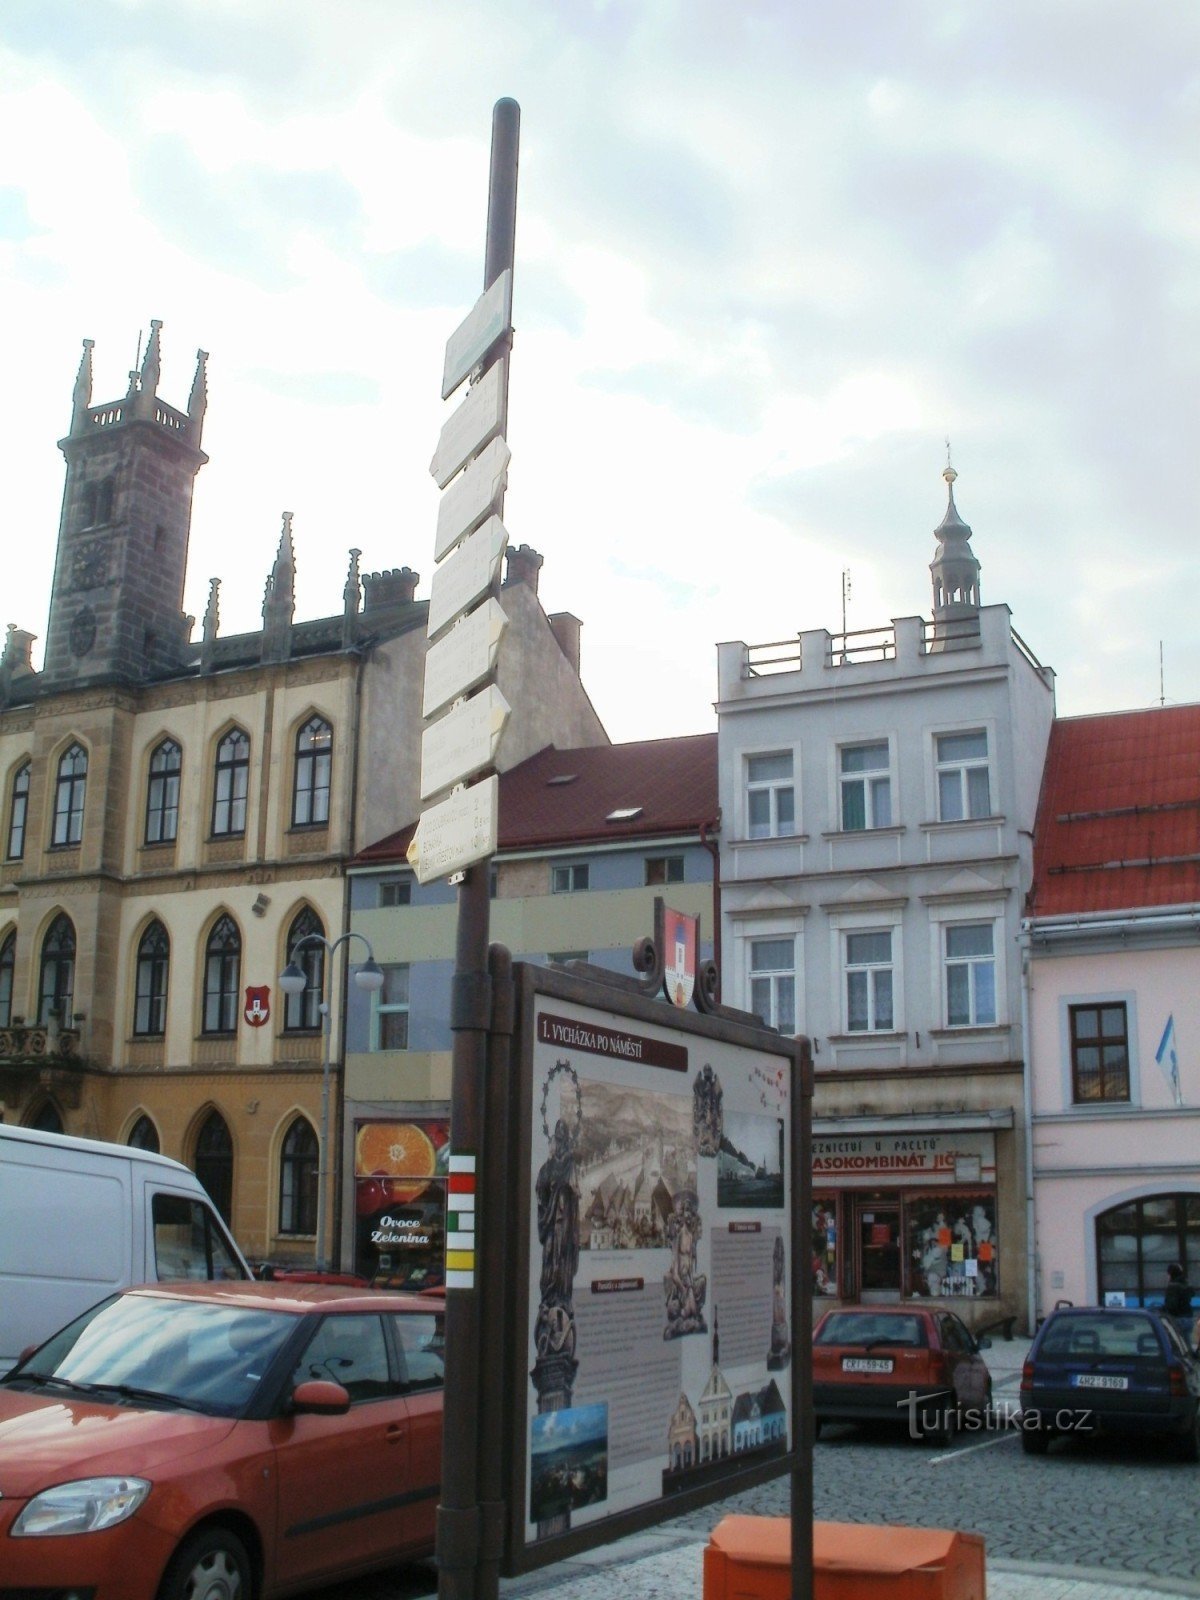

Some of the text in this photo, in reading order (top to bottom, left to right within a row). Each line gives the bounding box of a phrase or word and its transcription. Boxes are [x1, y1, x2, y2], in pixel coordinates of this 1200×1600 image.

[543, 1020, 642, 1057] 1. VYCHÁZKA PO NÁMĚSTÍ
[875, 1141, 882, 1151] U
[813, 1151, 957, 1169] ASOKOMBINÁT JIČ
[380, 1216, 420, 1227] Ovoce
[371, 1231, 429, 1243] Zelenina
[1079, 1376, 1096, 1386] 4H2
